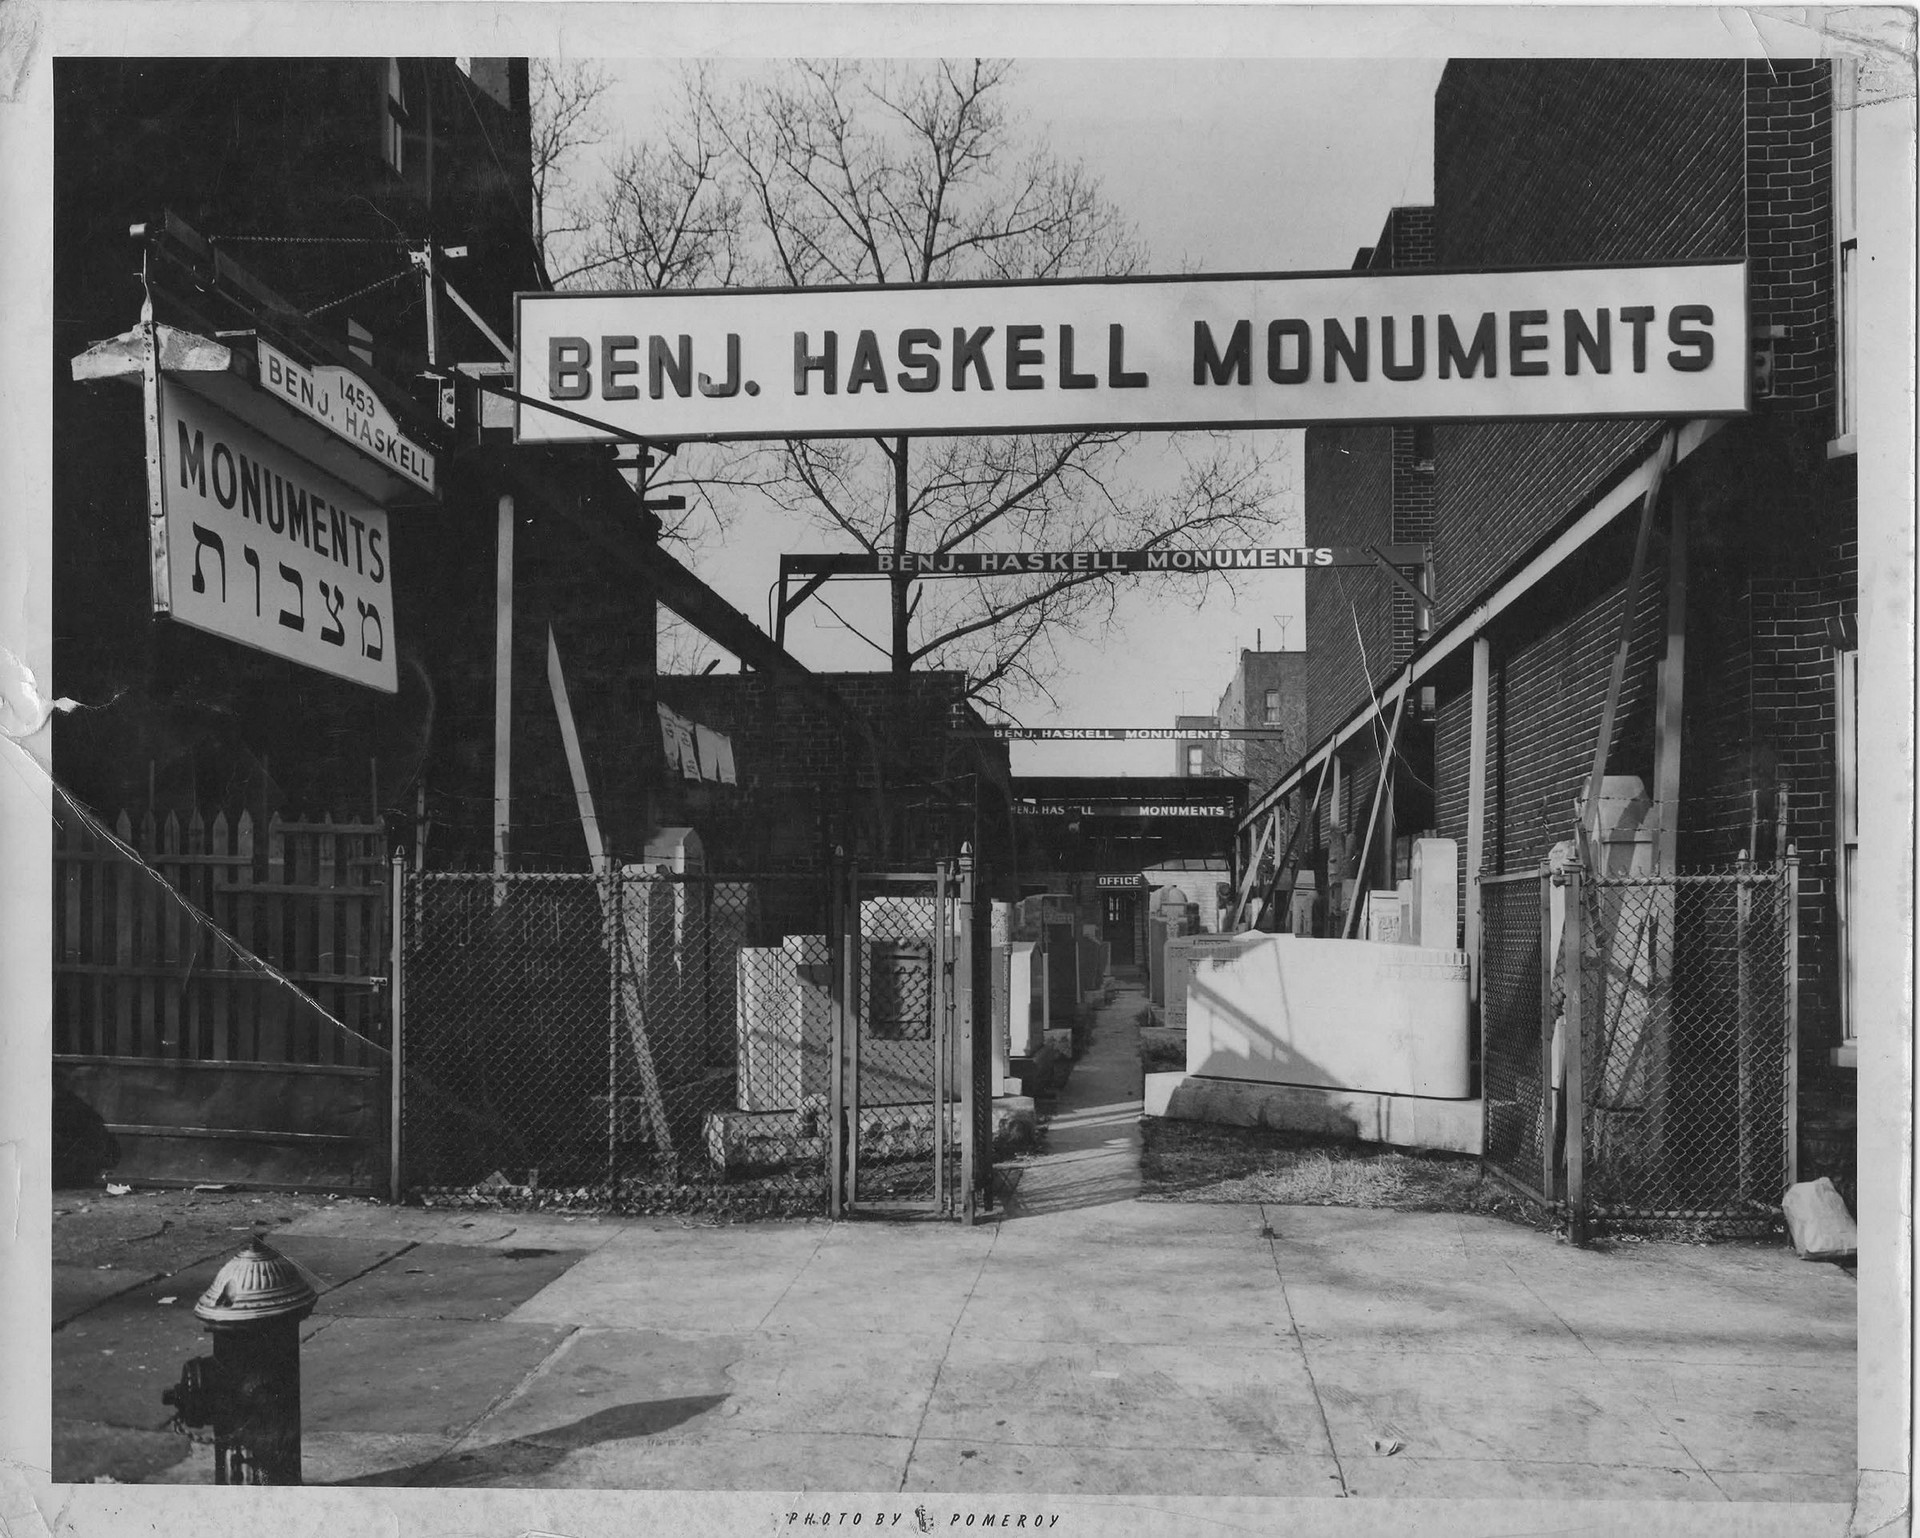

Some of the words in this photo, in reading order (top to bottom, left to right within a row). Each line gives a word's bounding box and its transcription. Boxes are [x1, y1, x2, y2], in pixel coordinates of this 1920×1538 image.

[548, 329, 761, 401] BENJ.
[793, 323, 1149, 396] HASKELL
[1193, 304, 1715, 386] MONUMENTS
[339, 375, 376, 417] 1453
[268, 353, 335, 423] BENJ.
[345, 412, 430, 483] HASKELL
[177, 418, 385, 584] MONUMENTS
[878, 554, 965, 573] BENJ.
[980, 551, 1128, 572] HASKELL
[1147, 547, 1334, 569] MONUMENTS
[191, 521, 384, 663] מצבות
[993, 729, 1037, 739] BENJ.
[1041, 729, 1115, 739] HASKELL
[1125, 730, 1231, 739] MONUMENTS
[1041, 805, 1095, 816] HASLL
[1139, 805, 1225, 816] MONUMENTS
[1099, 876, 1139, 886] OFFICE
